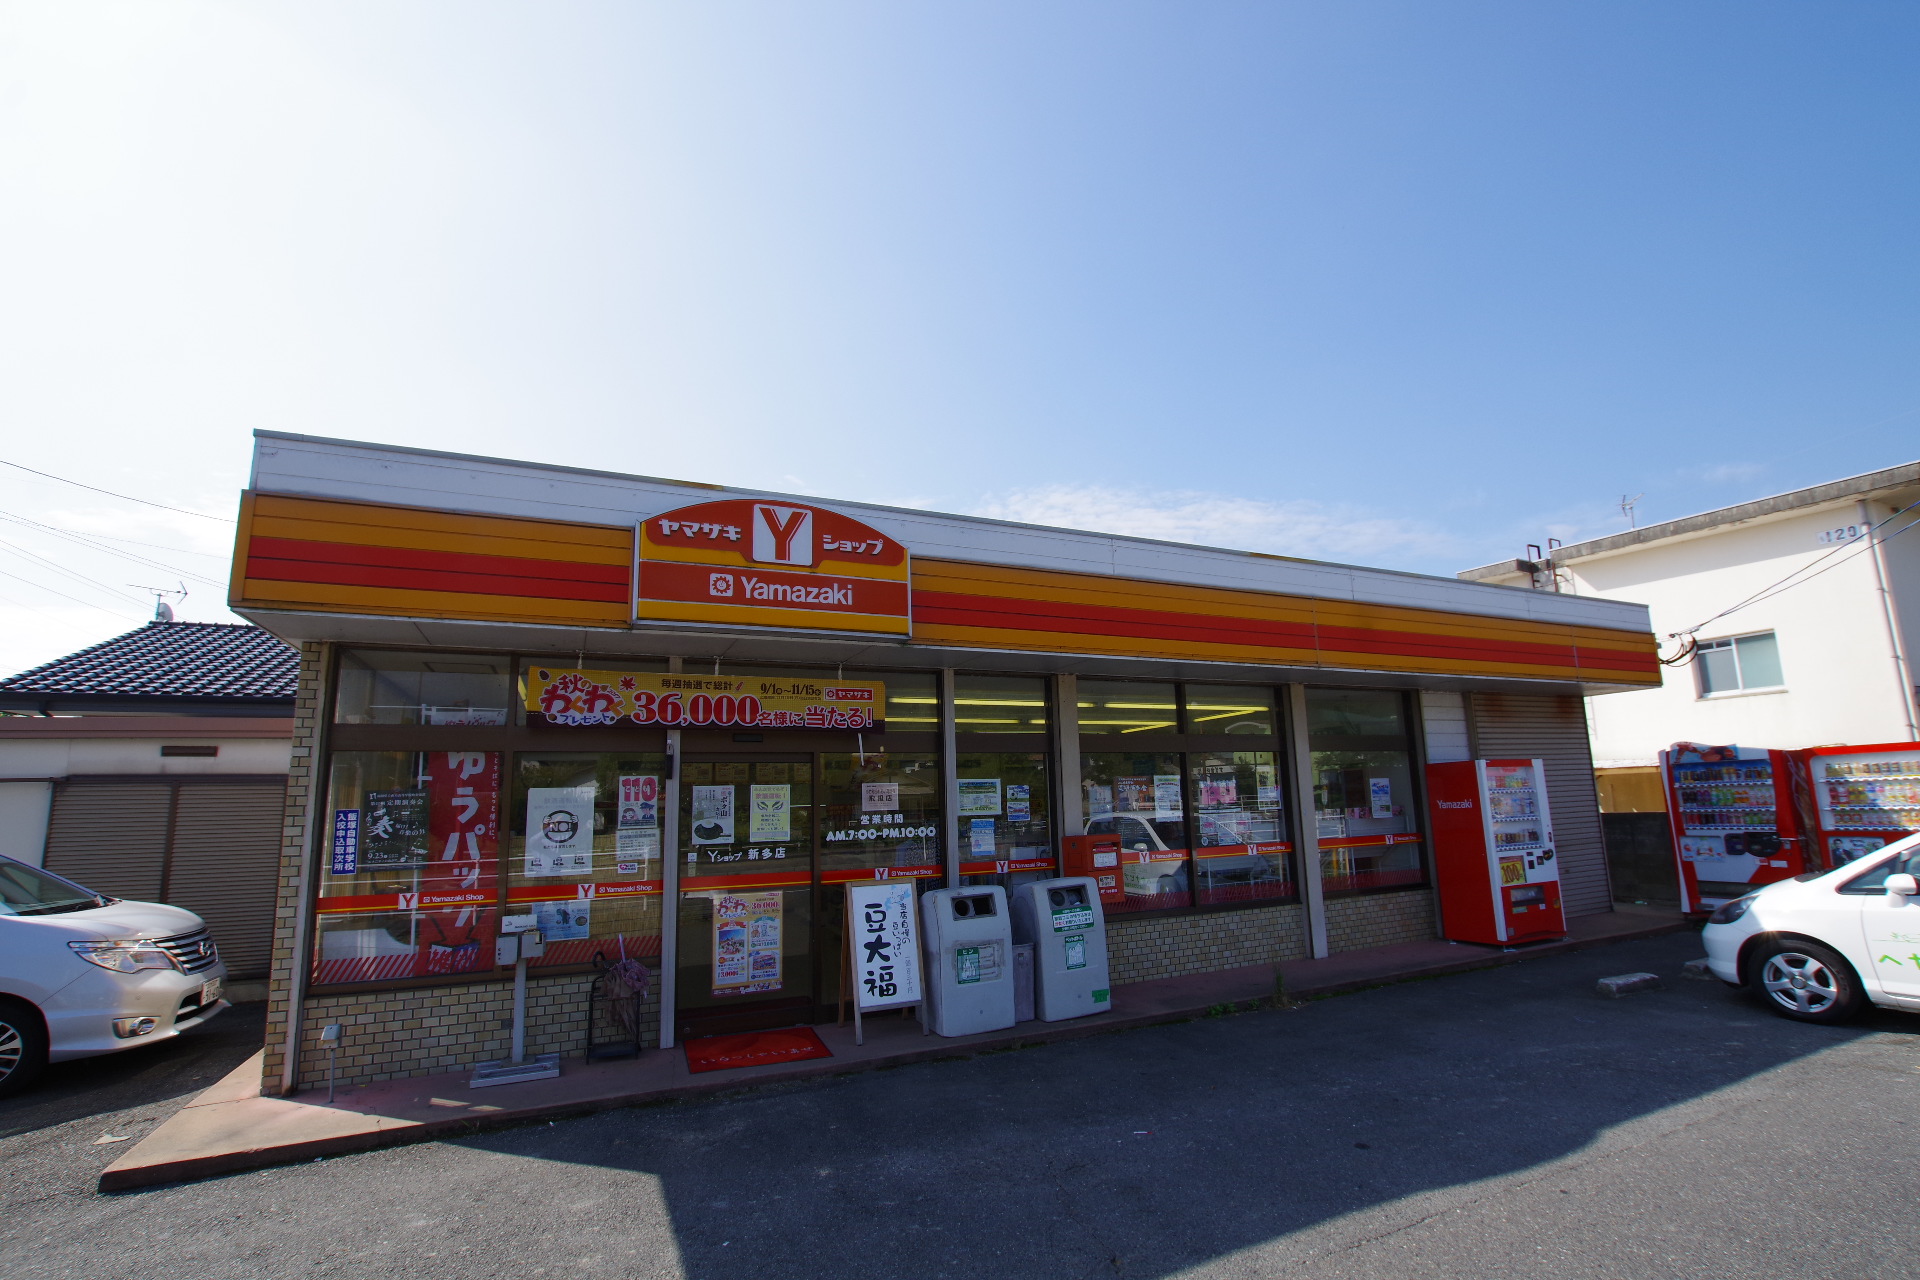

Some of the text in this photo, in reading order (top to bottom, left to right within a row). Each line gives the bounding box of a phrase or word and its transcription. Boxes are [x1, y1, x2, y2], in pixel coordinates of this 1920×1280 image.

[658, 507, 883, 561] ヤマザキ Y ショップ
[740, 576, 853, 605] Yamazaki
[558, 674, 592, 693] 秋の
[661, 679, 733, 690] 毎週抽選で総計
[540, 684, 624, 717] わくわく
[837, 690, 870, 699] ヤマザキ
[559, 713, 610, 725] プレゼント
[621, 777, 657, 802] 110
[1437, 800, 1473, 809] Yamazaki
[550, 821, 573, 832] NO!
[860, 814, 903, 825] 営業時間
[333, 813, 347, 871] 入校申込取次所
[344, 813, 358, 871] 飯塚自動車学校
[876, 869, 887, 879] Y
[997, 861, 1007, 873] Y
[431, 894, 484, 903] Yamazaki Shop
[580, 885, 592, 898] Y
[402, 894, 415, 909] Y
[899, 902, 911, 944] 当店自慢の
[864, 903, 898, 998] 豆大福
